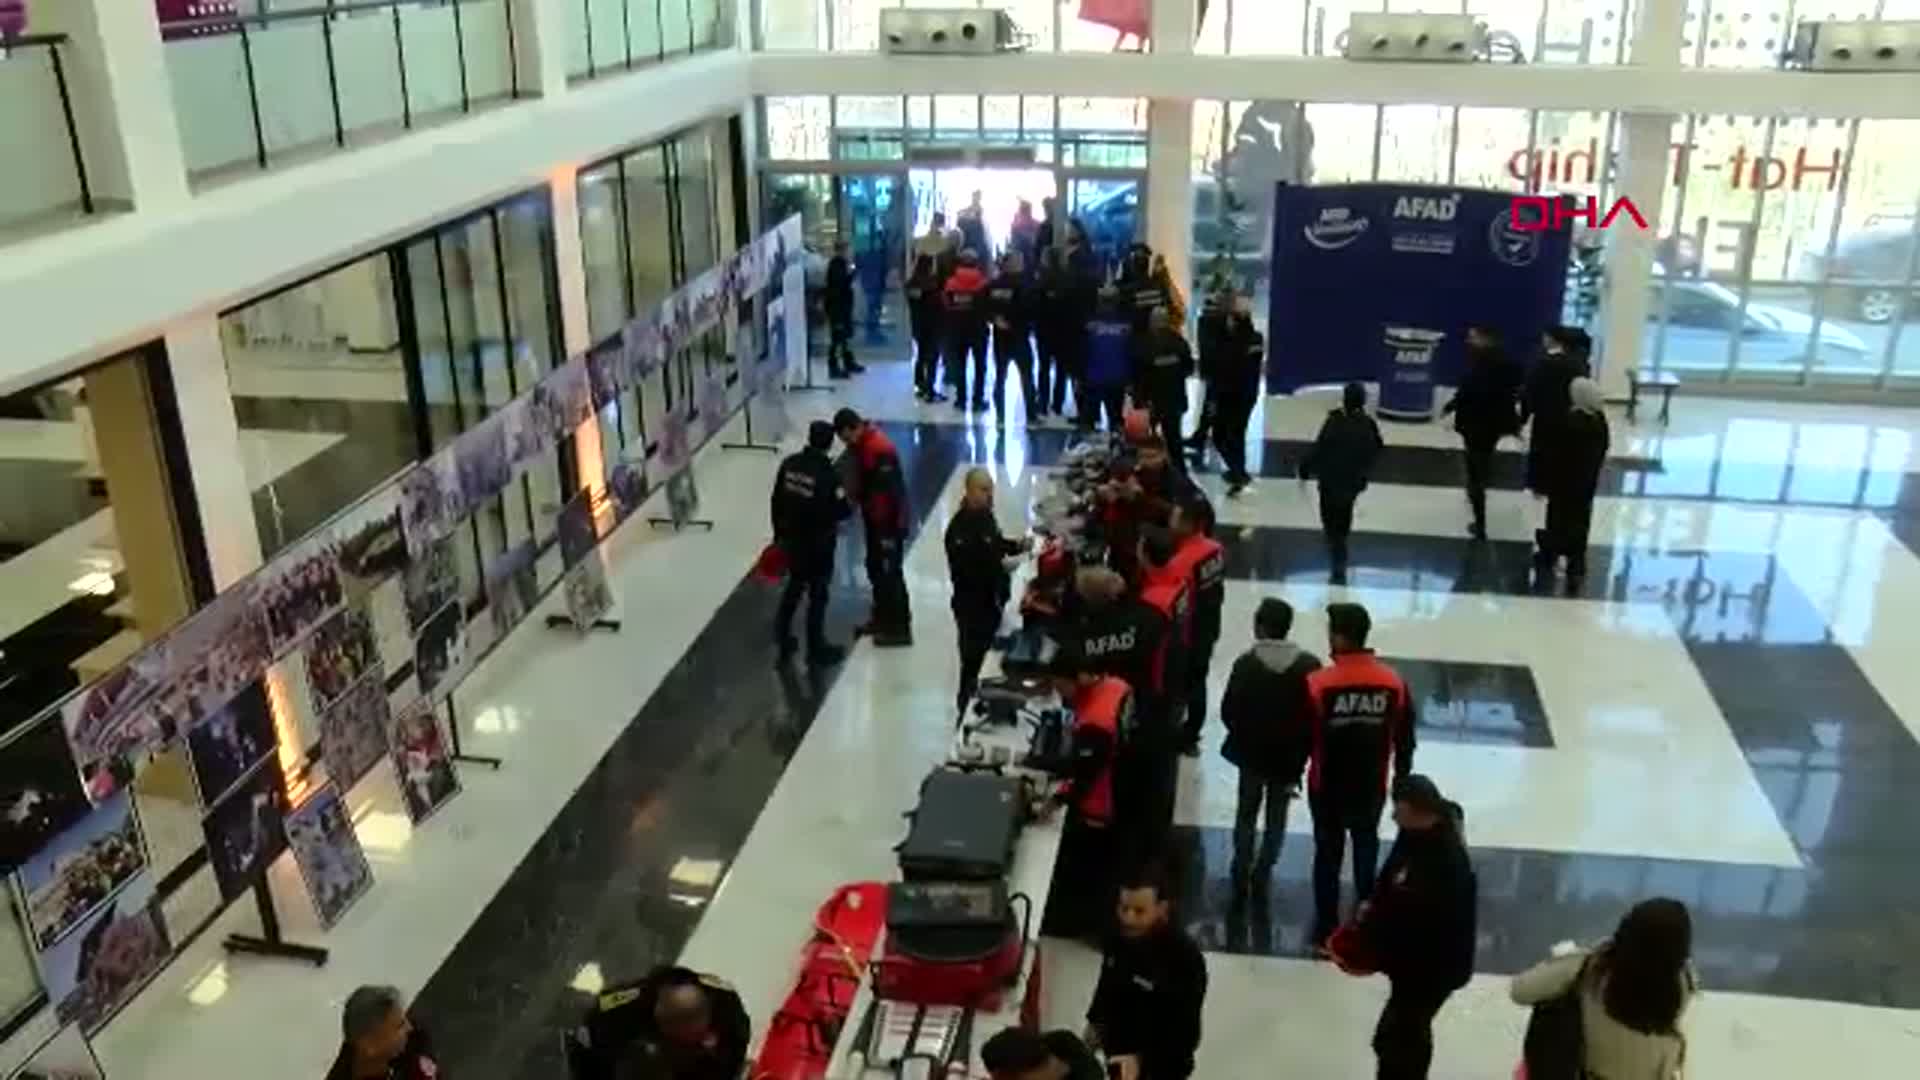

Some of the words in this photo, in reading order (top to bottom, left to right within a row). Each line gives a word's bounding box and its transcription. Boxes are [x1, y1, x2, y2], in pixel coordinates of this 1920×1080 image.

[1393, 196, 1458, 221] AFAD
[1085, 632, 1136, 656] AFAD
[1333, 692, 1387, 713] AFAD
